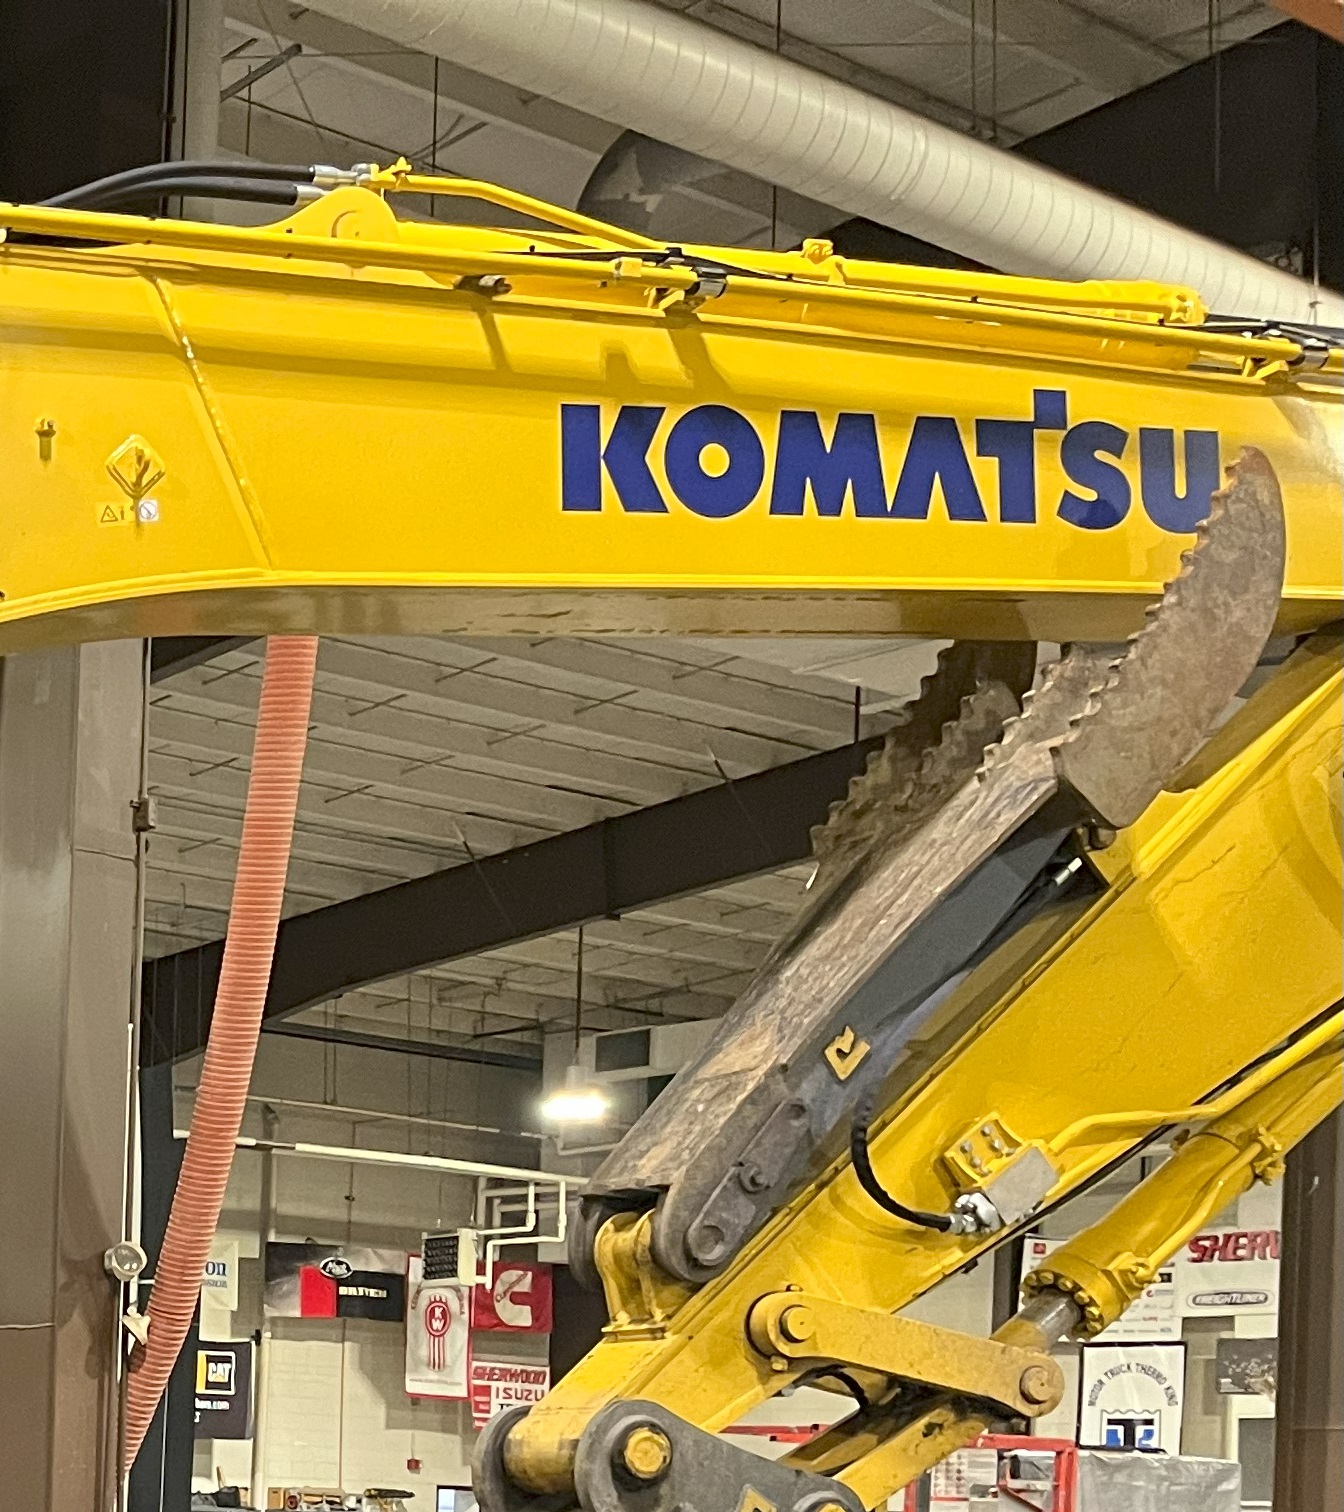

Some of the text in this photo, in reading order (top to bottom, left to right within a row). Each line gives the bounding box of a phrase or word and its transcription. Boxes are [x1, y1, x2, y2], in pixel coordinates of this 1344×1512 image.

[562, 390, 1219, 534] KOMATSU
[205, 1262, 227, 1277] on
[207, 1363, 231, 1383] CAT
[1104, 1363, 1133, 1380] TRUCK
[496, 1387, 545, 1401] ISUZU
